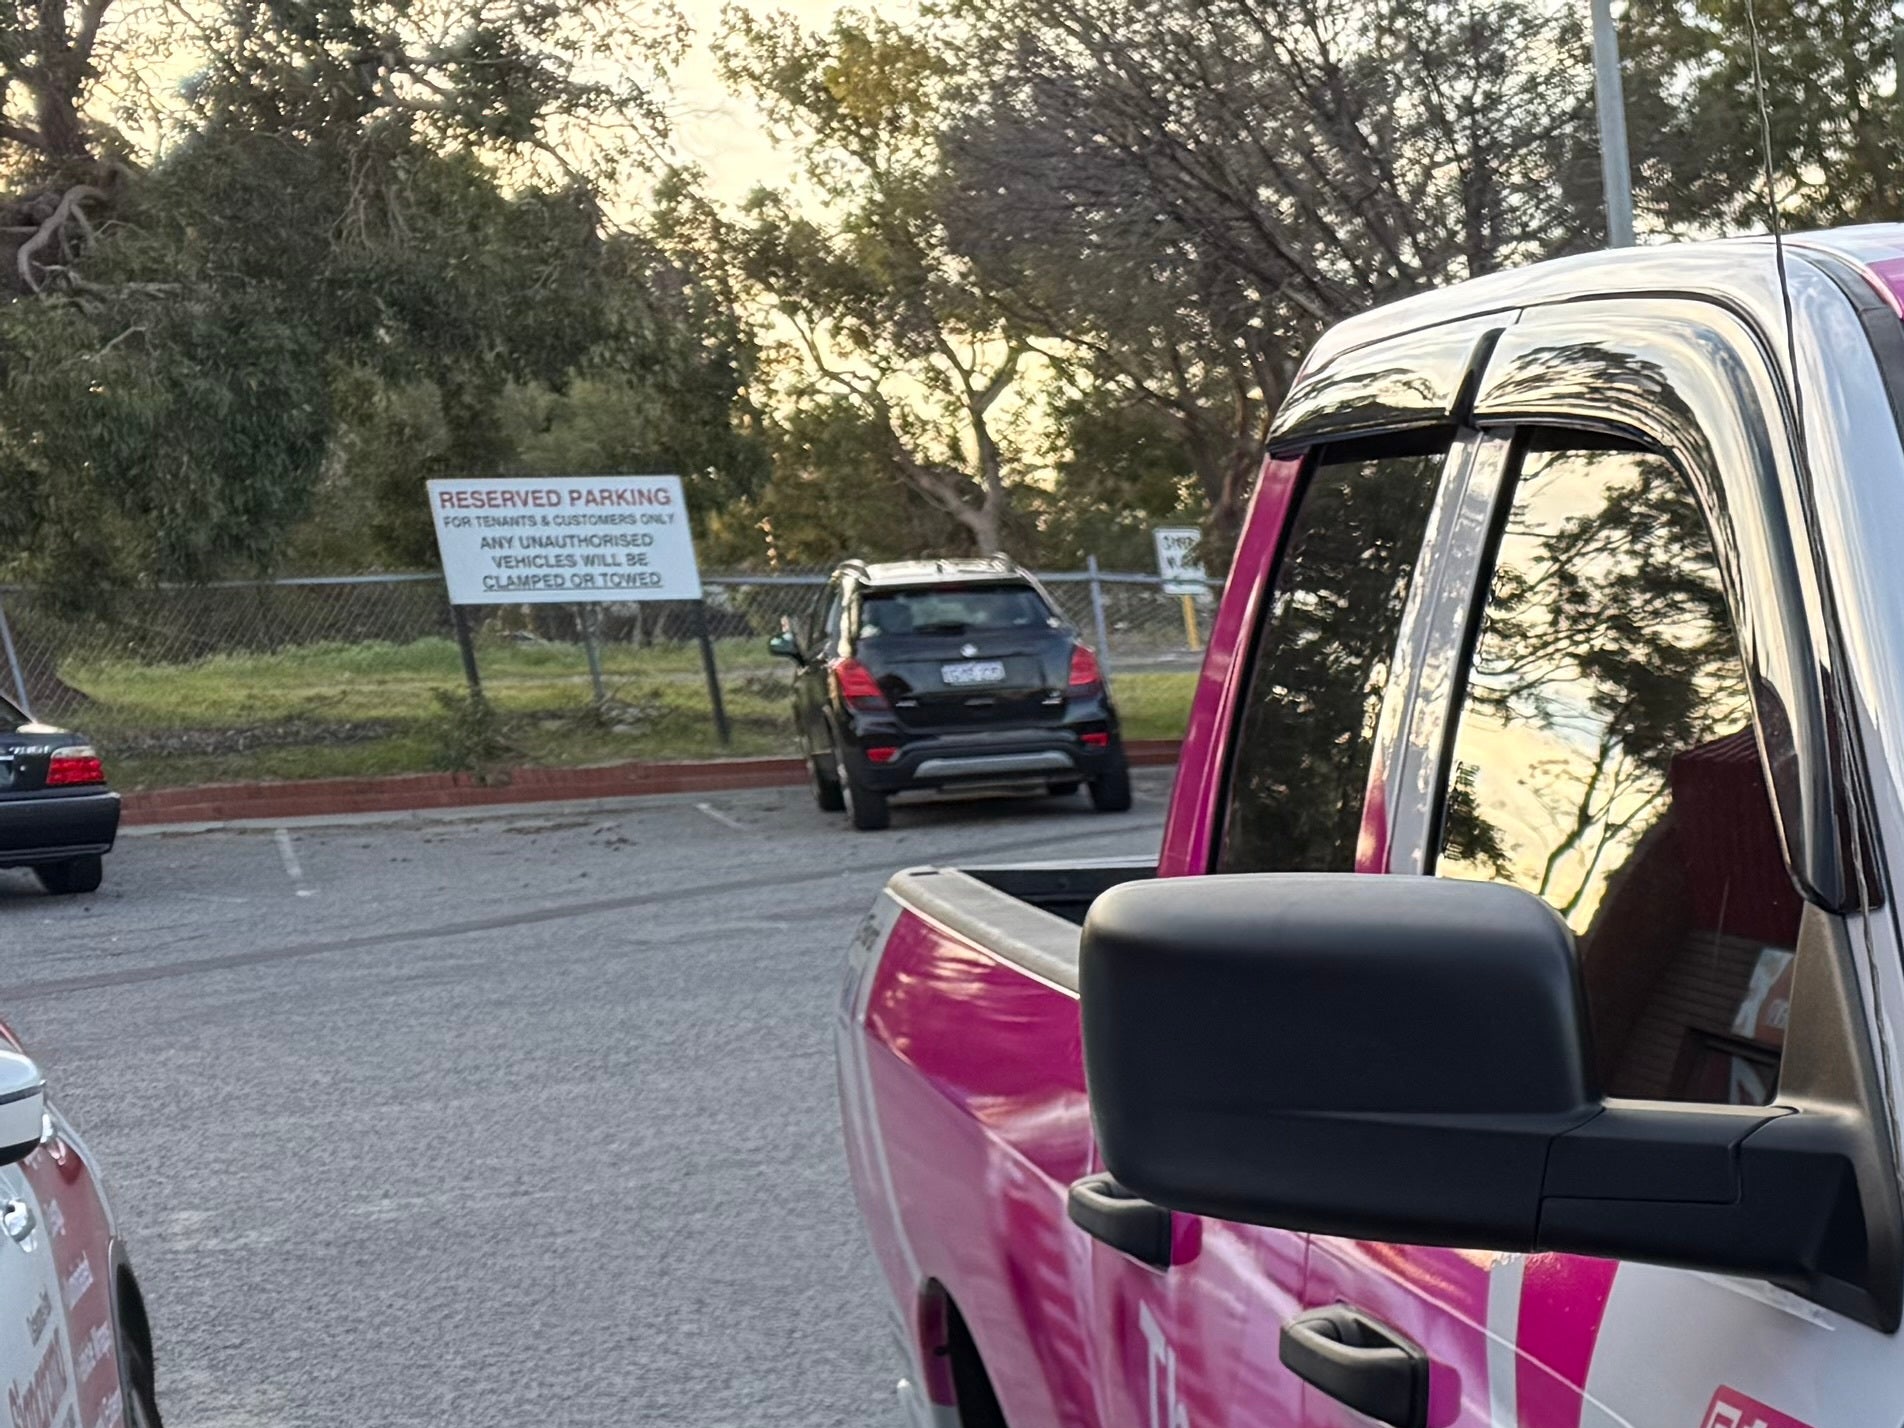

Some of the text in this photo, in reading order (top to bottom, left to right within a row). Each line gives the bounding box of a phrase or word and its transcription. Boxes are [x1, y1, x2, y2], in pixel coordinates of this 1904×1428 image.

[439, 488, 672, 509] RESERVED PARKING
[444, 513, 675, 529] FOR TENANTS & CUSTOMERS ONLY
[480, 533, 655, 551] ANY UNAUTHORISED
[492, 552, 649, 570] VEHICLES WILL BE
[482, 571, 663, 591] CLAMPED OR TOWED
